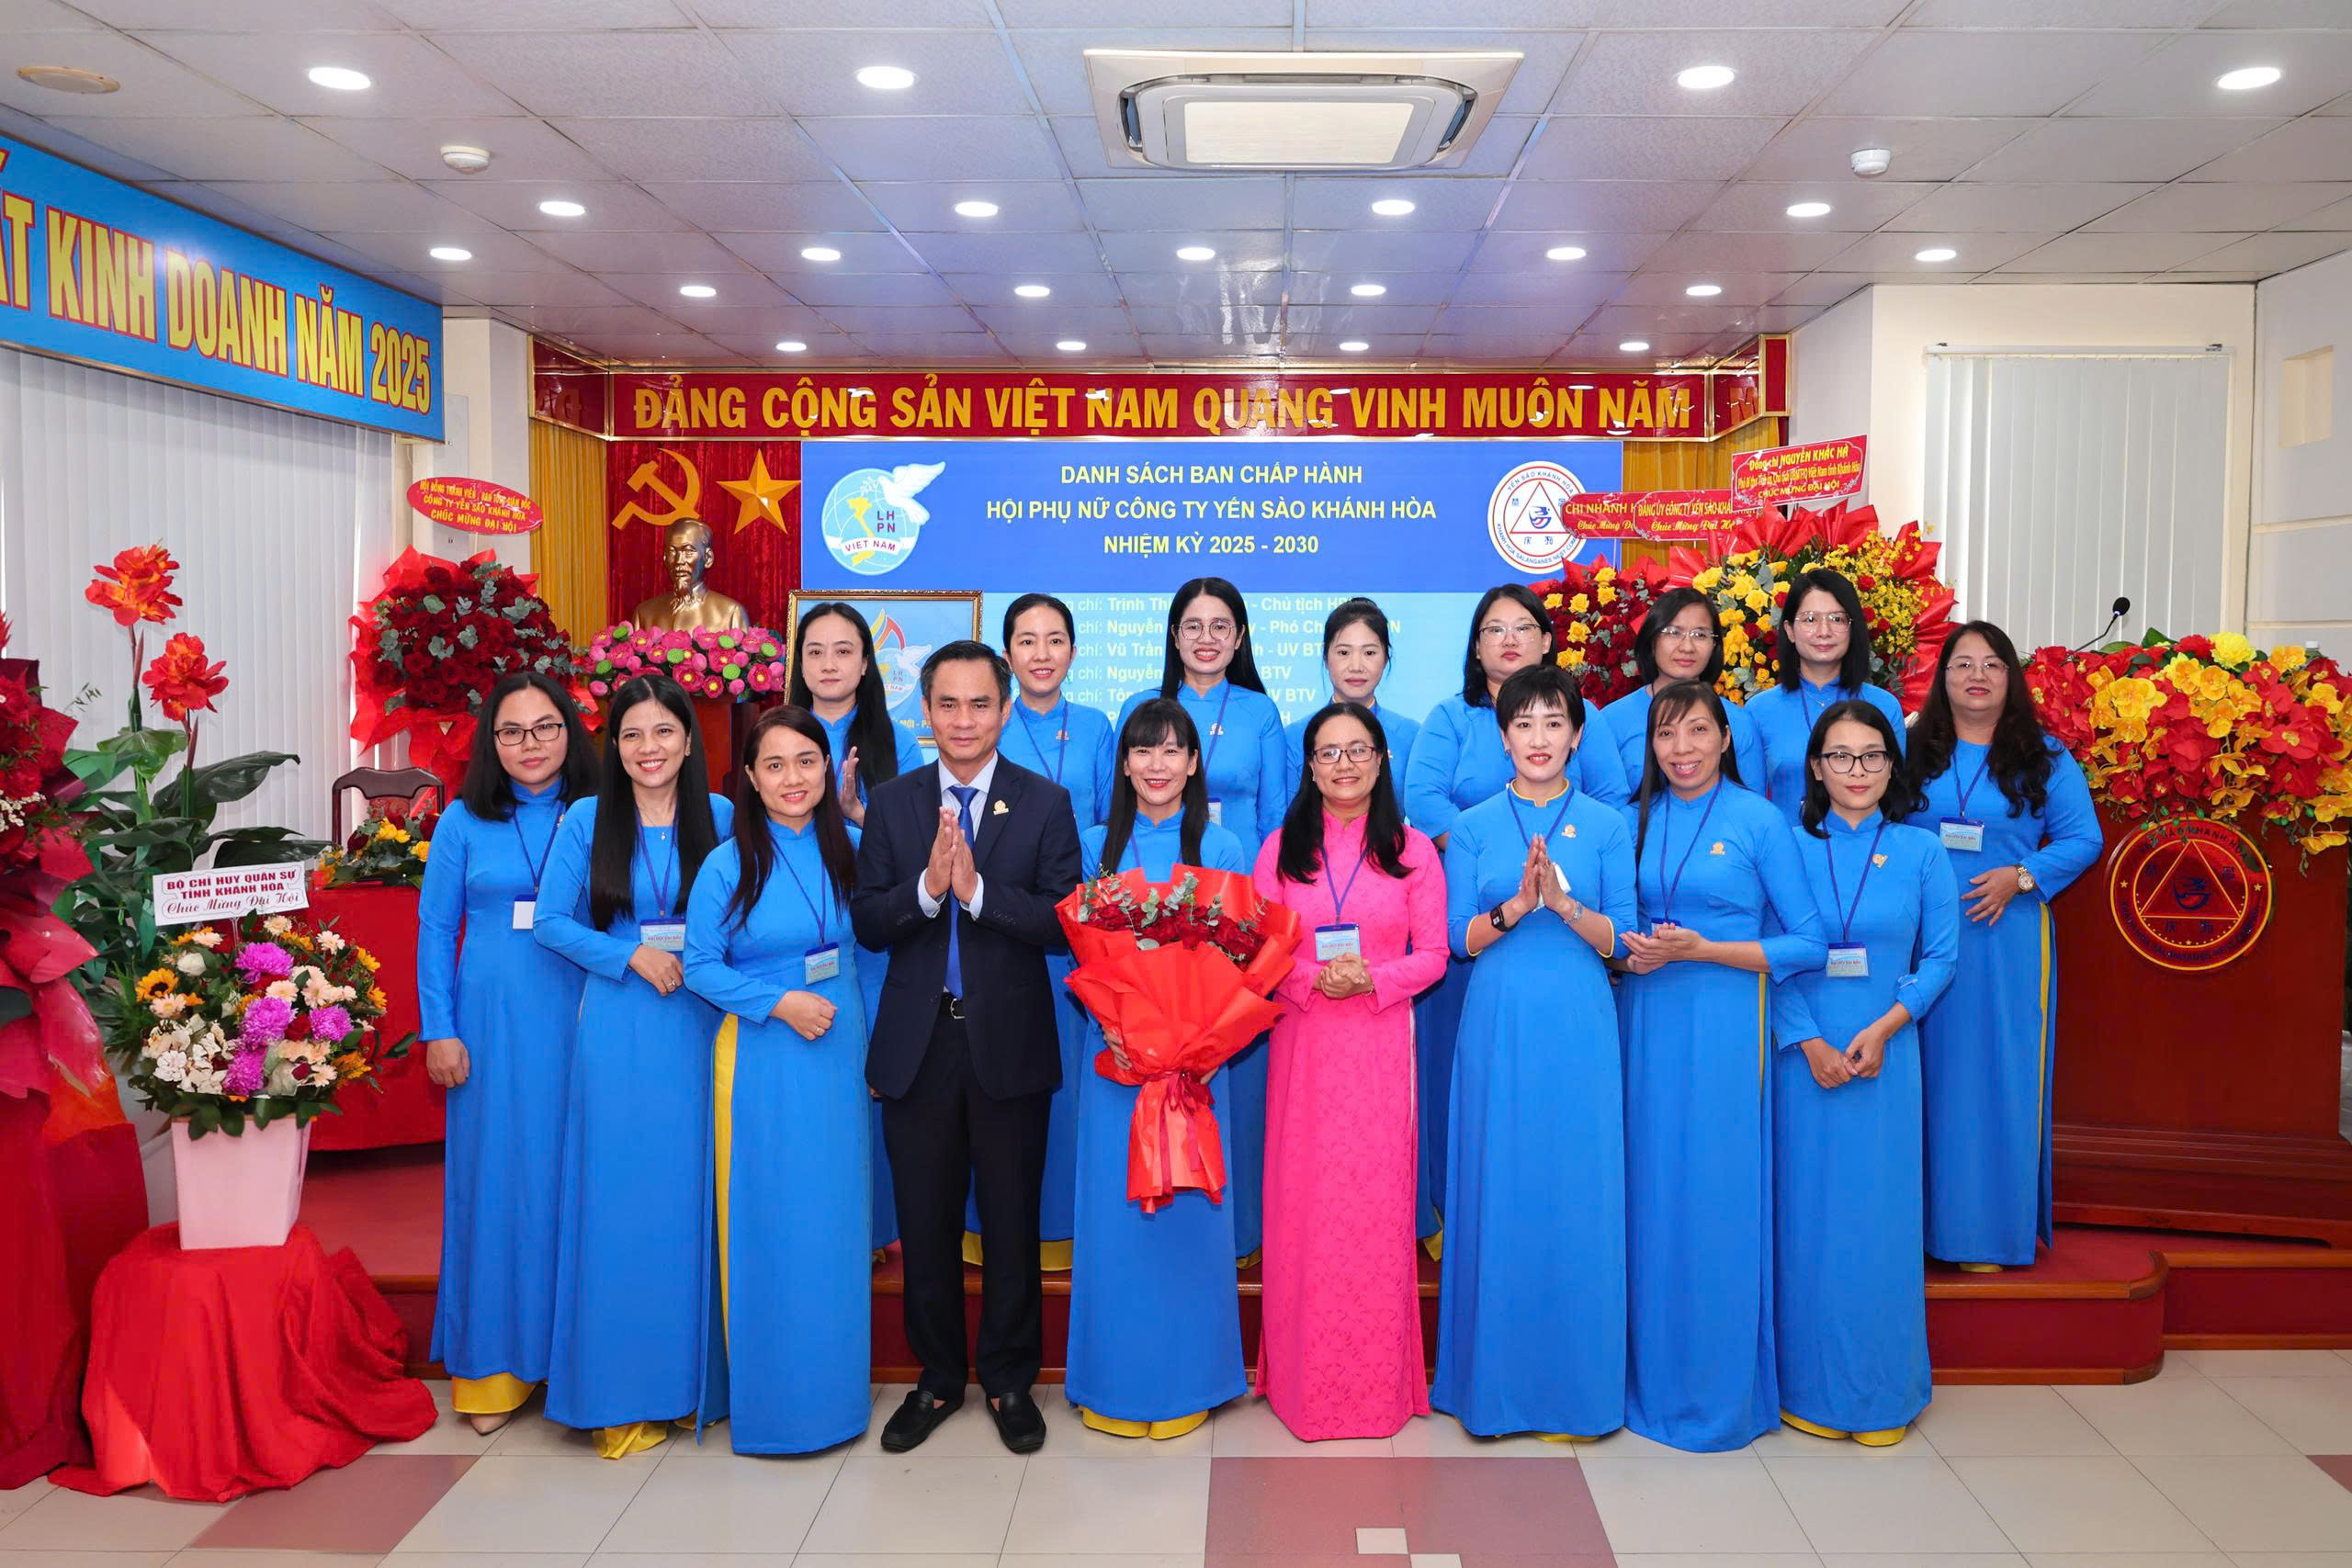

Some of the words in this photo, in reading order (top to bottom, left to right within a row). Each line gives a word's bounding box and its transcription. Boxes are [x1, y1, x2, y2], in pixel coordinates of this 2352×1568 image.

[46, 205, 157, 343] KINH
[165, 246, 288, 378] DOANH
[295, 283, 365, 399] NĂM
[370, 321, 432, 415] 2025
[633, 375, 746, 428] ĐẢNG
[763, 377, 876, 436] CỘNG
[889, 374, 971, 428] SẢN
[985, 378, 1076, 435] VIỆT
[1087, 388, 1178, 428] NAM
[1193, 388, 1332, 435] QUANG
[1351, 388, 1446, 428] VINH
[1463, 377, 1583, 428] MUÔN
[1599, 379, 1690, 428] NĂM
[1061, 466, 1120, 484] DANH
[1125, 461, 1183, 484] SÁCH
[1190, 466, 1234, 484] BAN
[1240, 461, 1297, 484] CHẤP
[1304, 461, 1363, 484] HÀNH
[877, 511, 895, 521] LH
[987, 499, 1023, 524] HỘI
[1029, 501, 1071, 524] PHỤ
[1078, 496, 1110, 519] NỮ
[1114, 496, 1176, 519] CÔNG
[1182, 501, 1208, 519] TY
[1213, 496, 1255, 519] YẾN
[1261, 496, 1306, 519] SÀO
[1312, 496, 1385, 519] KHÁNH
[1391, 496, 1436, 519] HÒA
[1566, 503, 1583, 514] CHI
[431, 509, 454, 522] CHÚC
[458, 513, 481, 526] MỪNG
[485, 518, 500, 530] ĐẠI
[503, 521, 516, 533] HỘI
[877, 523, 896, 533] PN
[874, 540, 895, 551] NAM
[1103, 533, 1169, 558] NHIỆM
[1176, 532, 1204, 553] KỲ
[1209, 536, 1255, 553] 2025
[1273, 536, 1318, 553] 2030
[1107, 597, 1144, 615] Trịnh
[1261, 596, 1291, 611] Chủ
[1295, 597, 1322, 615] tịch
[1107, 618, 1163, 637] Nguyễn
[1271, 620, 1298, 634] Phó
[1303, 620, 1323, 634] Ch
[1278, 643, 1298, 657] UV
[1303, 643, 1324, 657] BT
[1107, 664, 1163, 682] Nguyễn
[1261, 666, 1292, 680] BTV
[1285, 689, 1316, 702] BTV
[167, 879, 185, 891] BỘ
[216, 875, 240, 886] HUY
[245, 872, 276, 883] QUÂN
[279, 869, 297, 881] SỰ
[166, 901, 199, 914] Chúc
[204, 897, 242, 911] Mừng
[276, 893, 299, 905] Hội
